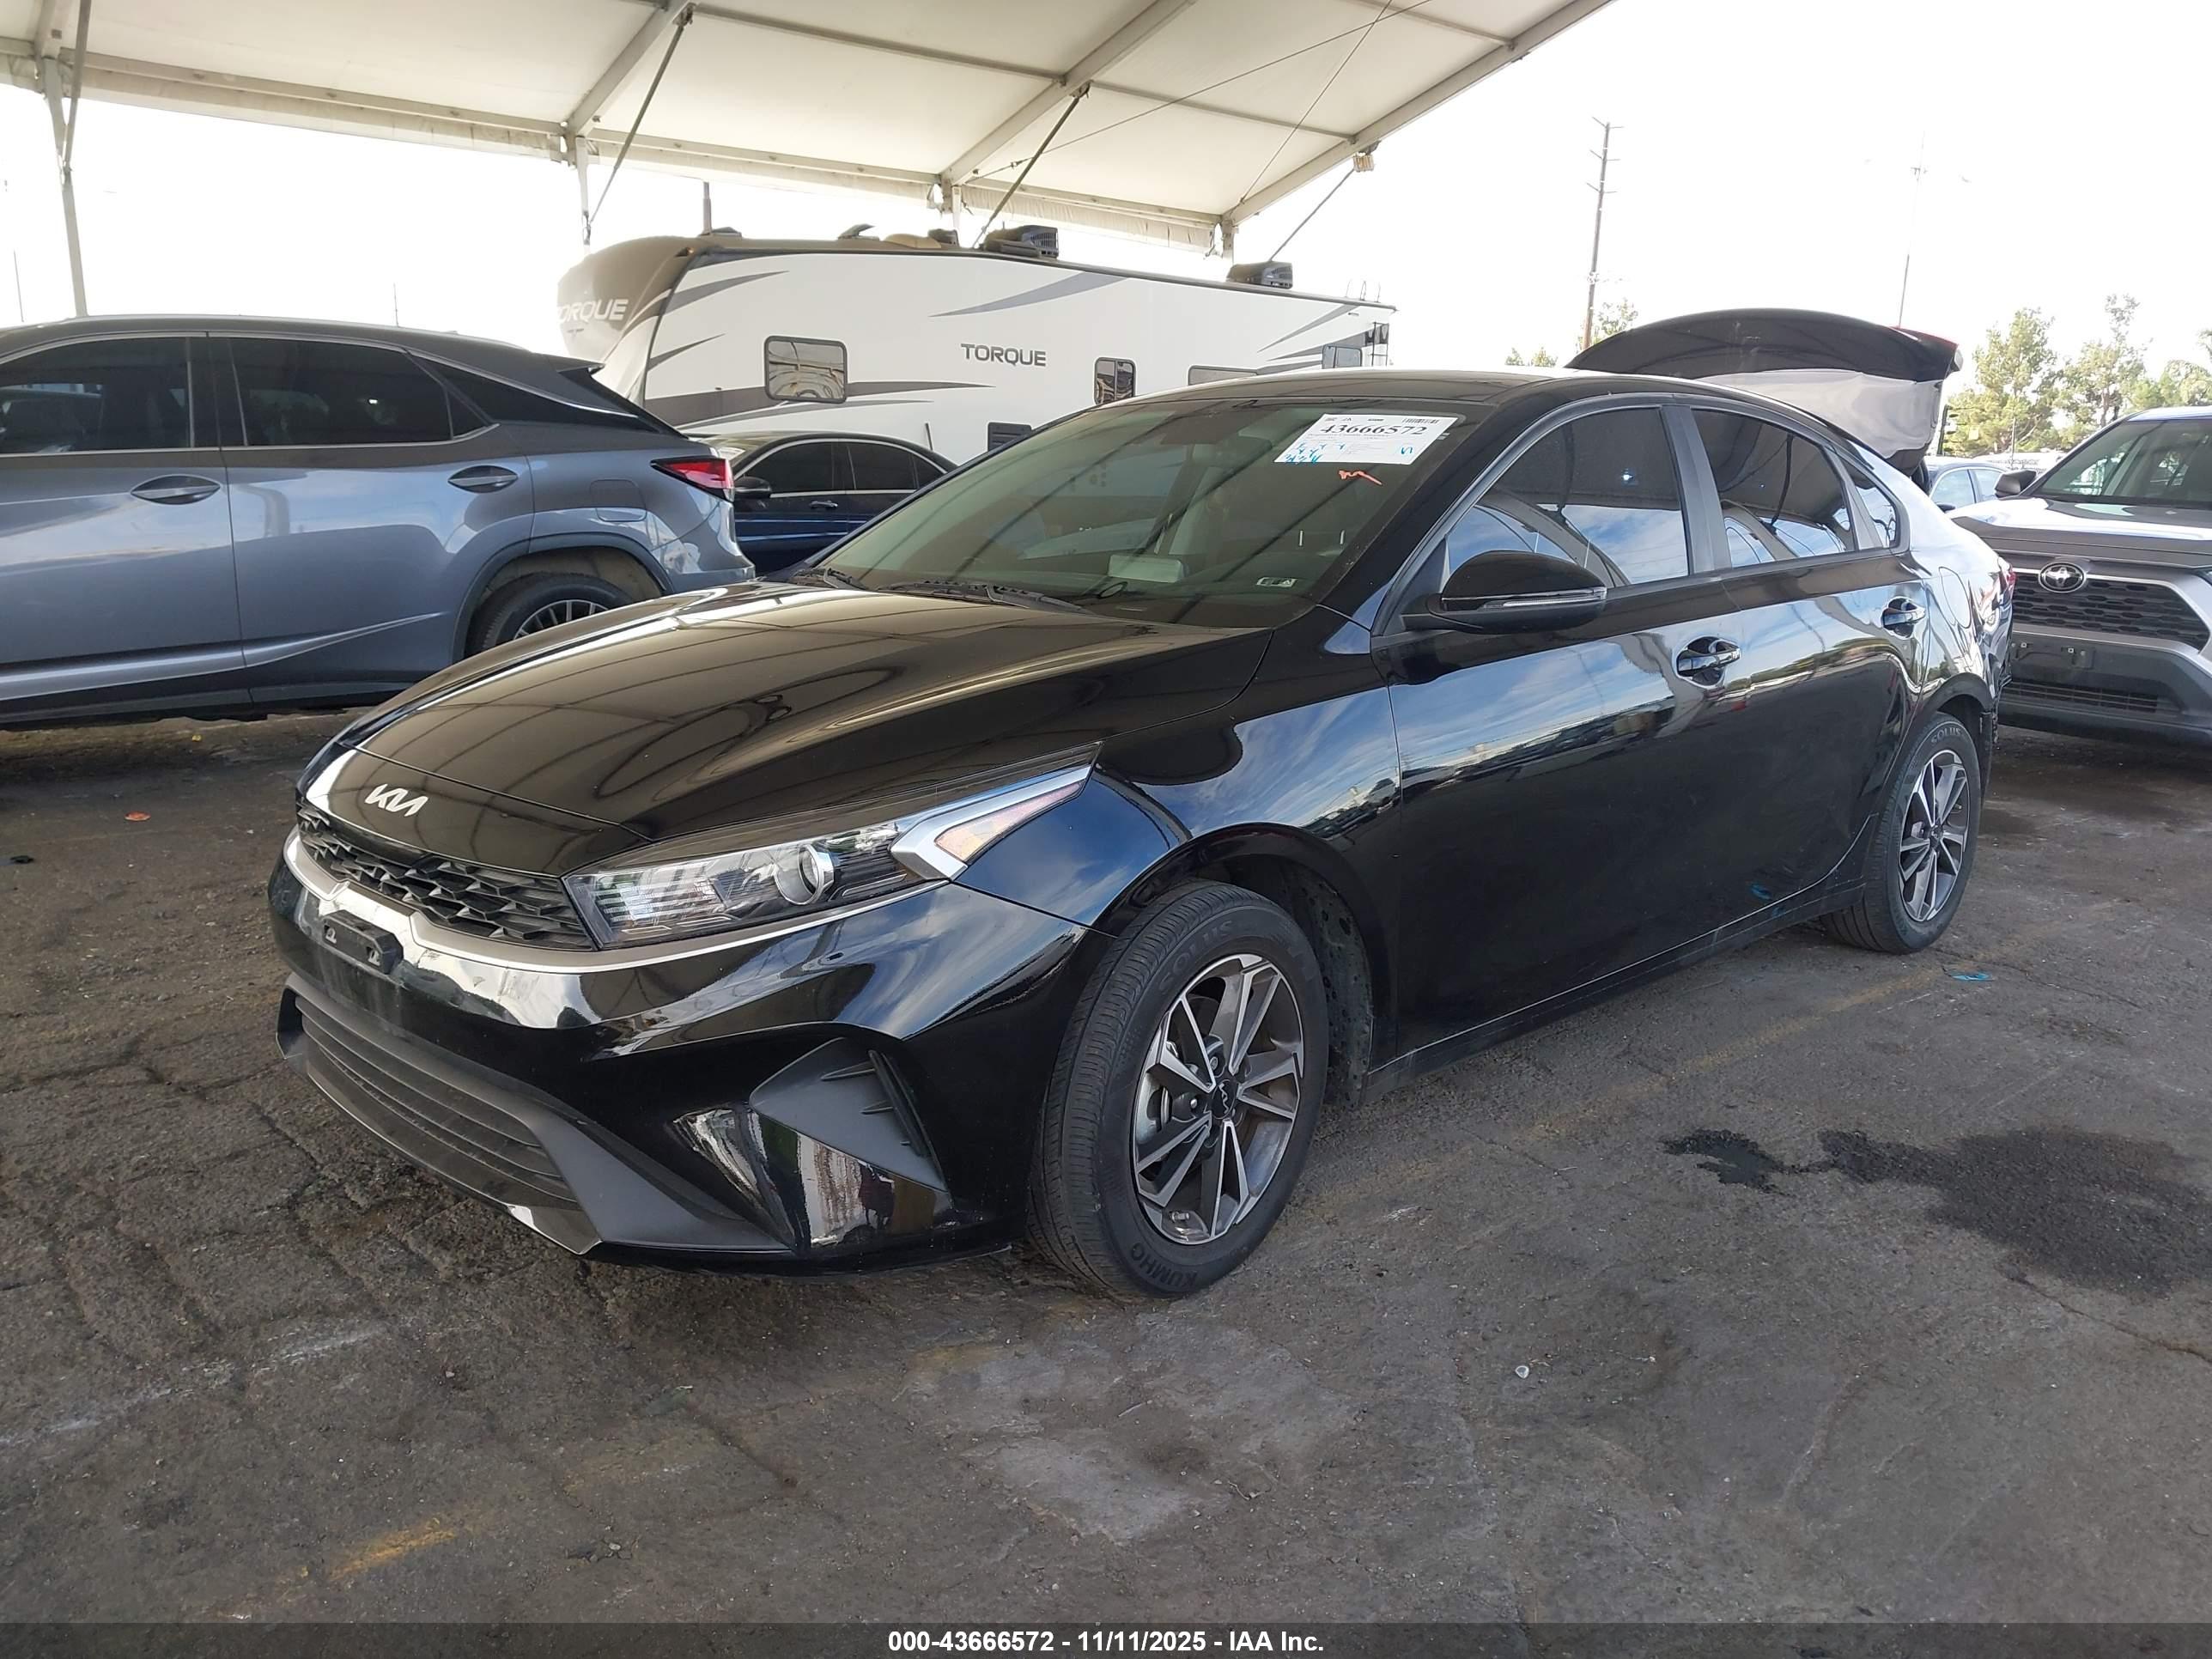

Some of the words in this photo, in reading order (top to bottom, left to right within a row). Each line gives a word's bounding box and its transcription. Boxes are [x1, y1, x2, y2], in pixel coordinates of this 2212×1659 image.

[556, 299, 629, 324] ORQUE
[960, 343, 1046, 367] TORQUE
[1320, 423, 1428, 435] 43666572
[1930, 726, 1962, 744] SOLUS
[364, 783, 428, 817] KIA
[1158, 919, 1235, 994] SOLUS
[1131, 1242, 1198, 1286] KUMHO
